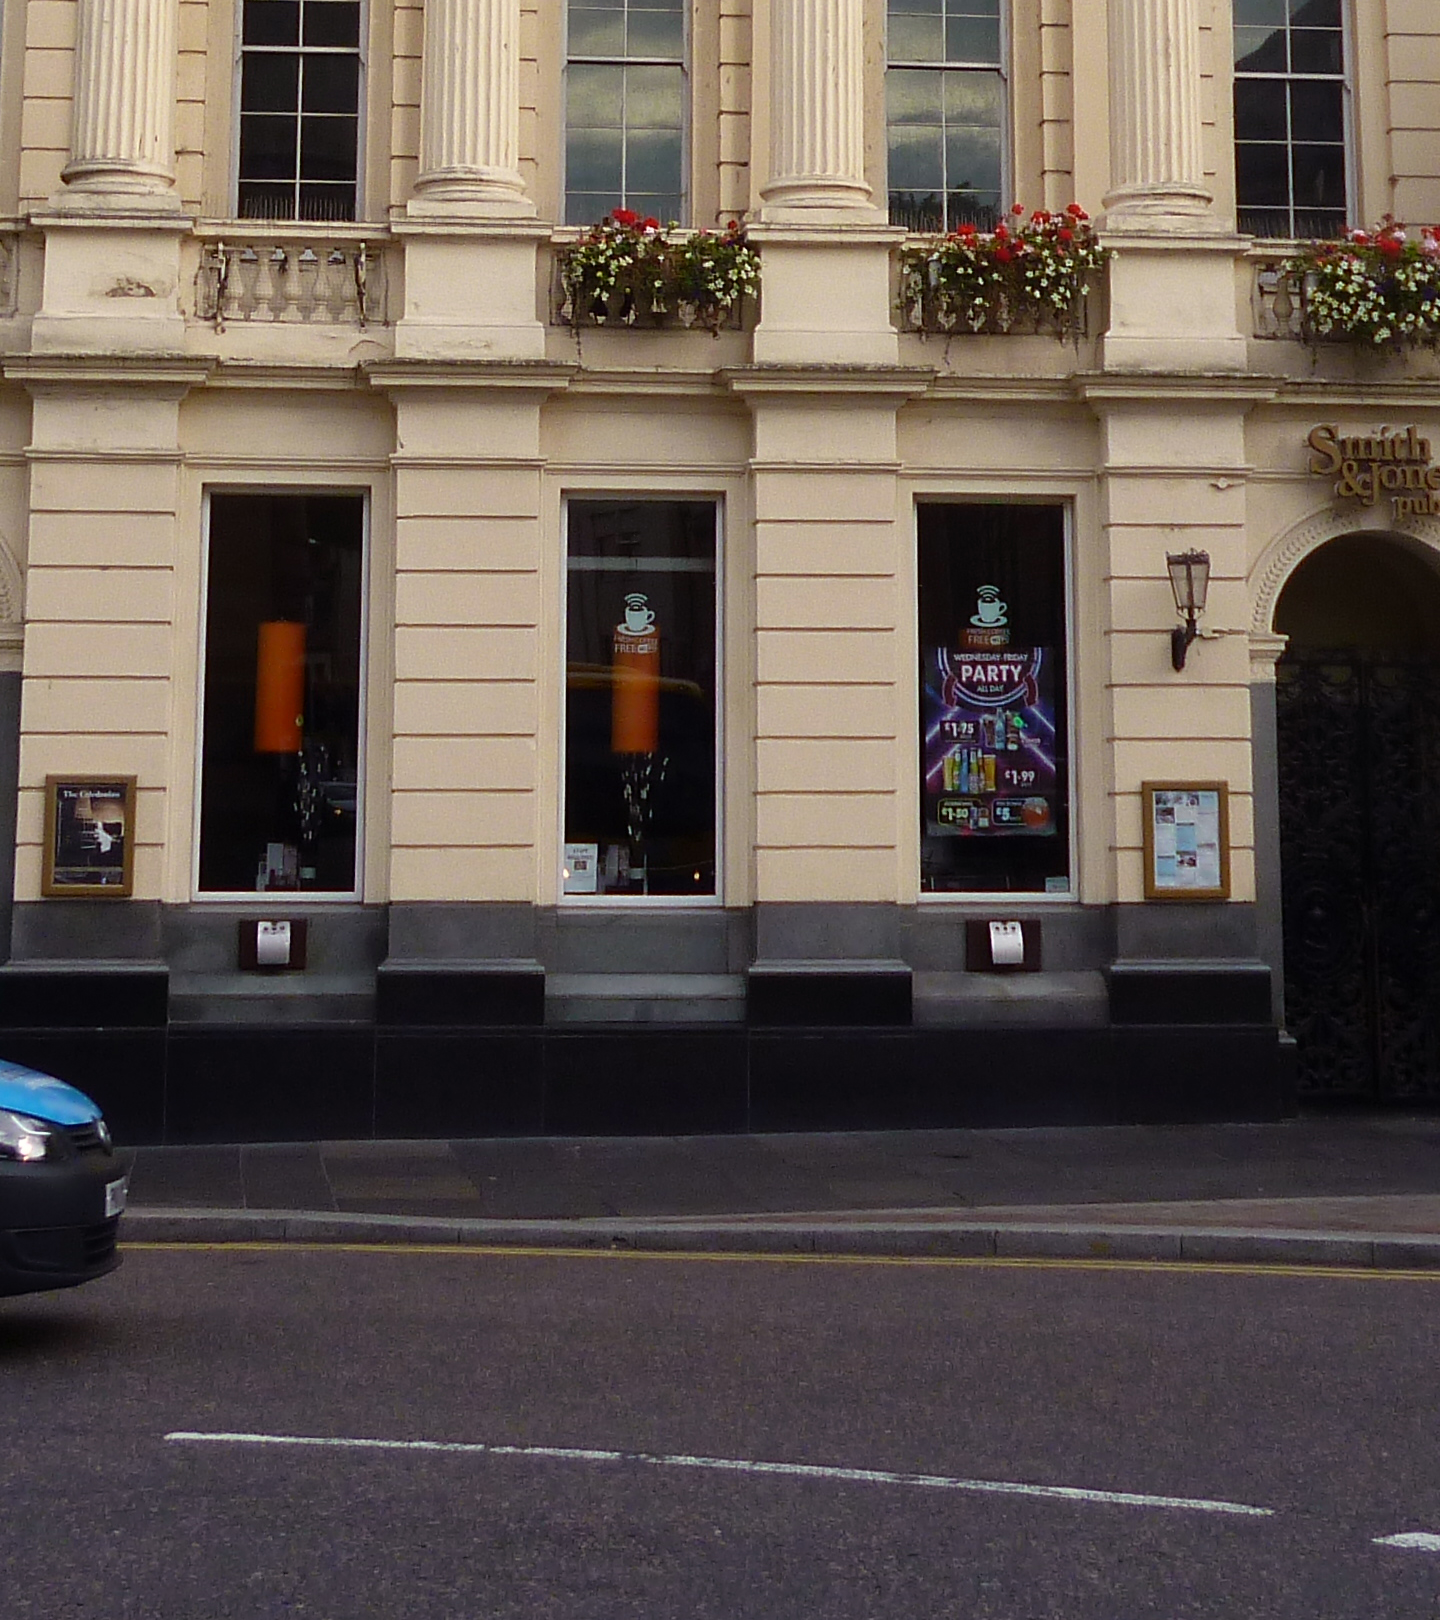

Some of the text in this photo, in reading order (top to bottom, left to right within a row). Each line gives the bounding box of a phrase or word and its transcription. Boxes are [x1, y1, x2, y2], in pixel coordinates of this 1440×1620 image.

[1307, 422, 1434, 475] Smith
[961, 664, 1022, 683] PARTY
[990, 684, 1005, 693] DAY
